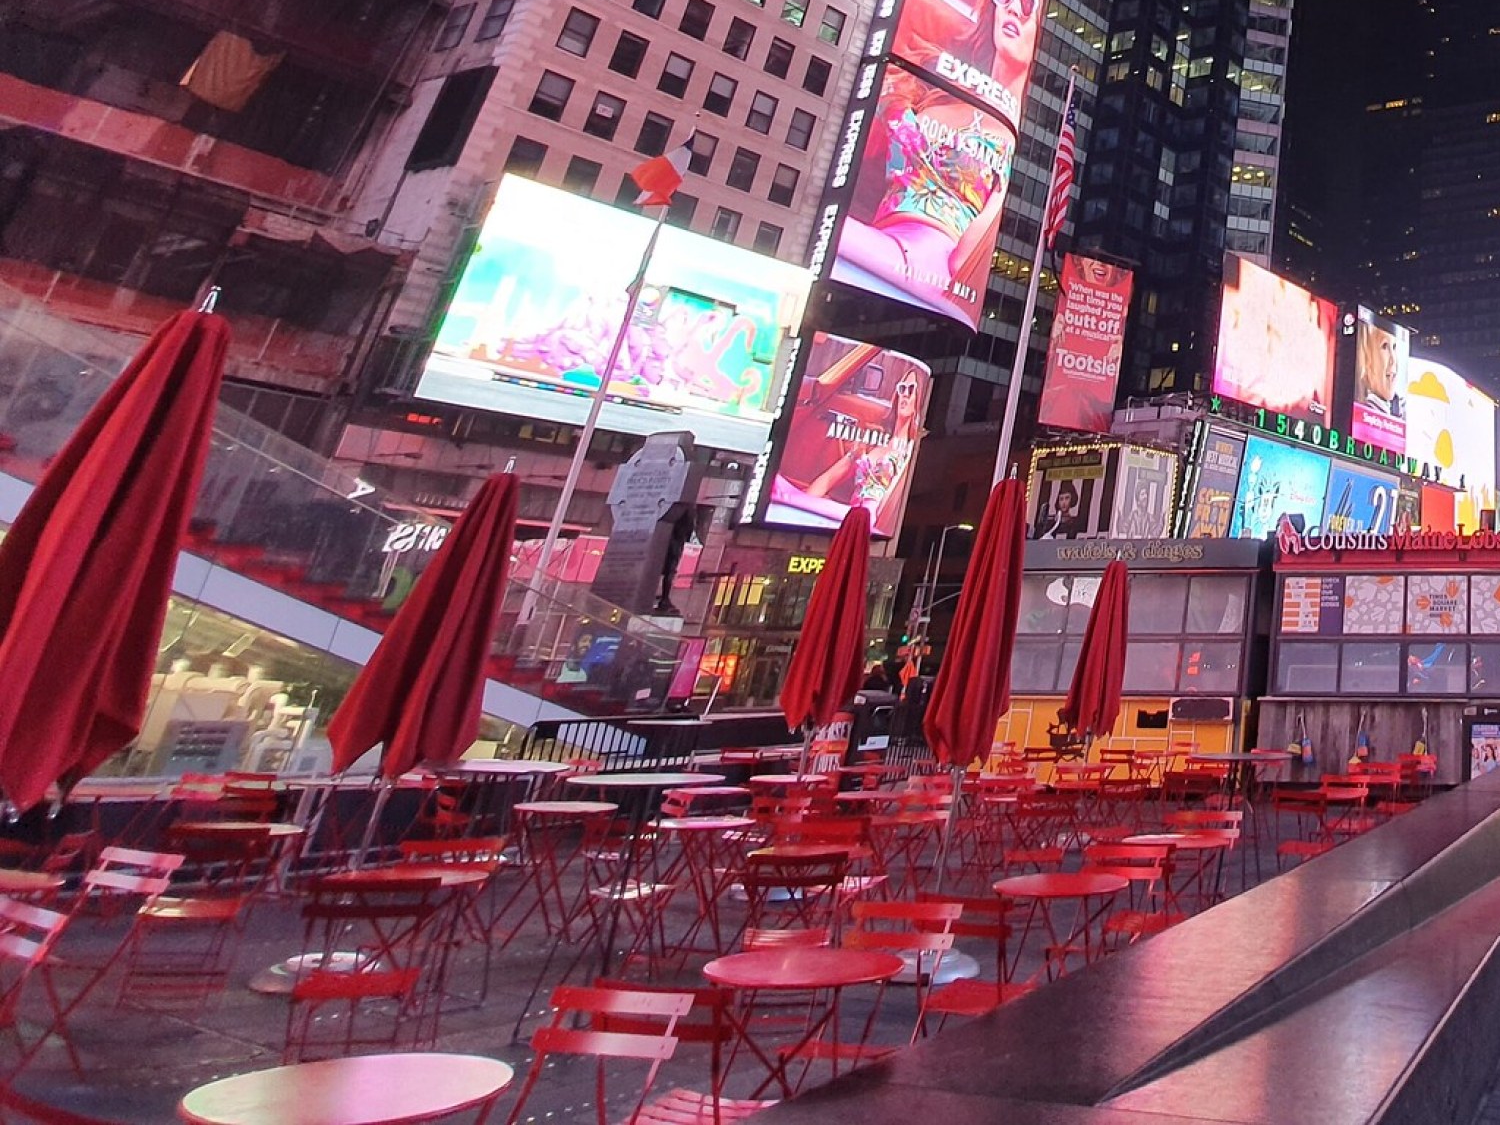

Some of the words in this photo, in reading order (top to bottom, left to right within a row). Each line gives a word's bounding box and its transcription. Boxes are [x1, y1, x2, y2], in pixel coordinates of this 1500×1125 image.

[936, 51, 1018, 121] EXPRESS
[832, 109, 865, 190] EXPRESS
[953, 281, 970, 300] MAY
[1069, 290, 1085, 303] last
[1086, 295, 1106, 307] time
[1107, 300, 1123, 311] you
[1095, 289, 1110, 301] was
[1111, 293, 1123, 303] the
[1065, 308, 1097, 330] butt
[1098, 319, 1120, 335] off
[1067, 299, 1101, 315] laughed
[1102, 309, 1121, 320] your
[1056, 347, 1117, 377] Tootsie
[826, 422, 892, 448] AVAILABLE
[1257, 408, 1323, 445] 1540
[1329, 431, 1443, 484] BROADWAY
[1305, 524, 1388, 551] Cousins
[1390, 525, 1456, 551] Maine
[1142, 541, 1204, 563] dinges
[1429, 593, 1448, 601] TIMES
